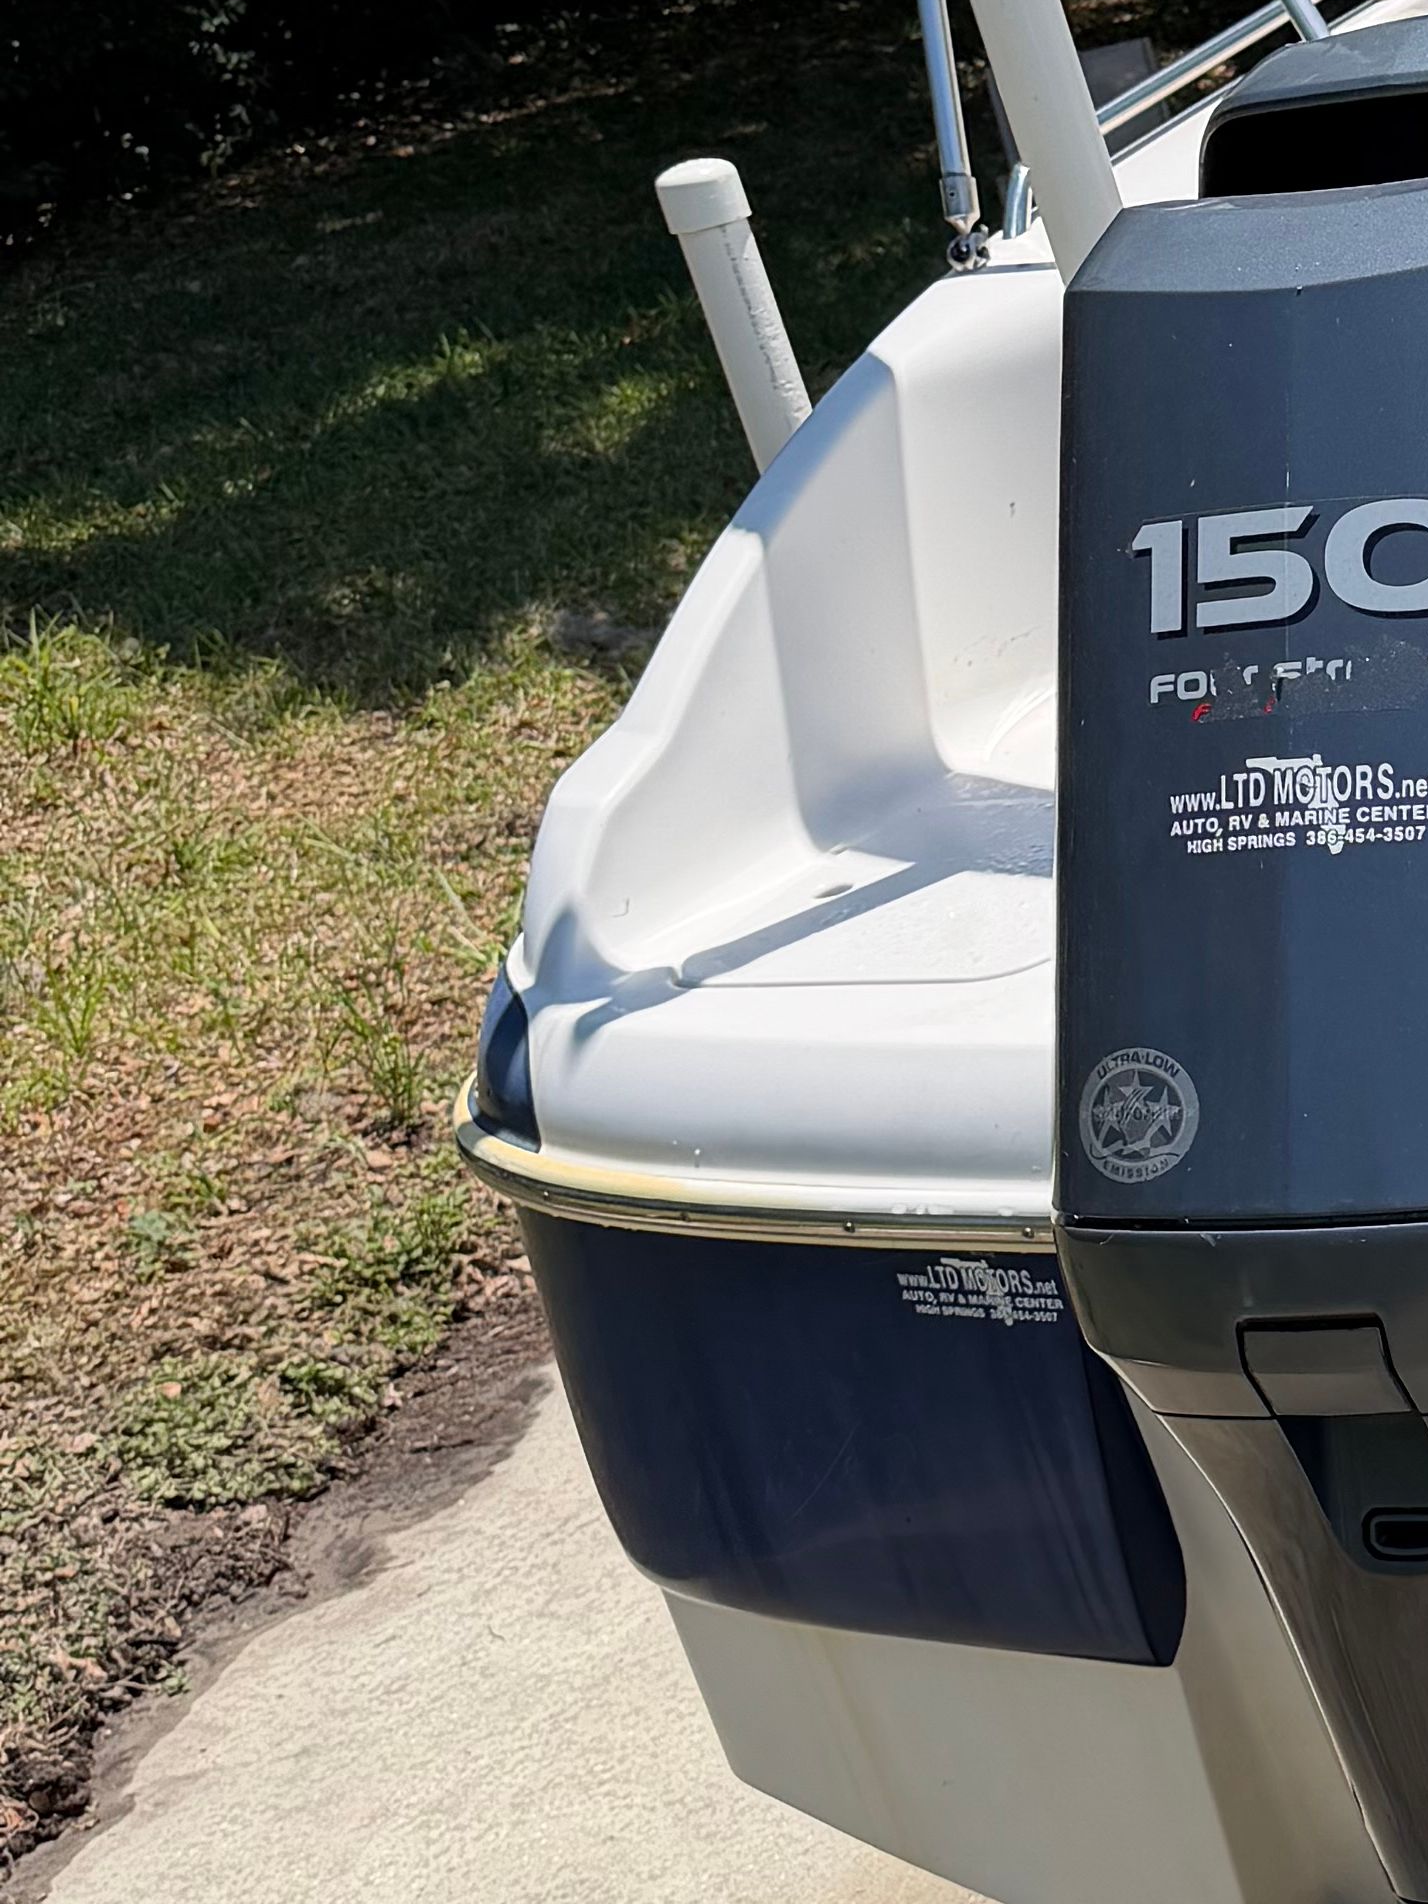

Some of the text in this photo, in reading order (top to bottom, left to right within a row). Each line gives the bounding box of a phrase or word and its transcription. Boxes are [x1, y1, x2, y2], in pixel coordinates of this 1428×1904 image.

[1170, 817, 1223, 837] AUTO,
[1229, 814, 1252, 831] RV
[1257, 813, 1270, 828] &
[1275, 807, 1351, 827] MARINE
[1187, 826, 1426, 854] HIGH SPRINGS 386-454-3507
[1014, 1296, 1064, 1310] CENTER
